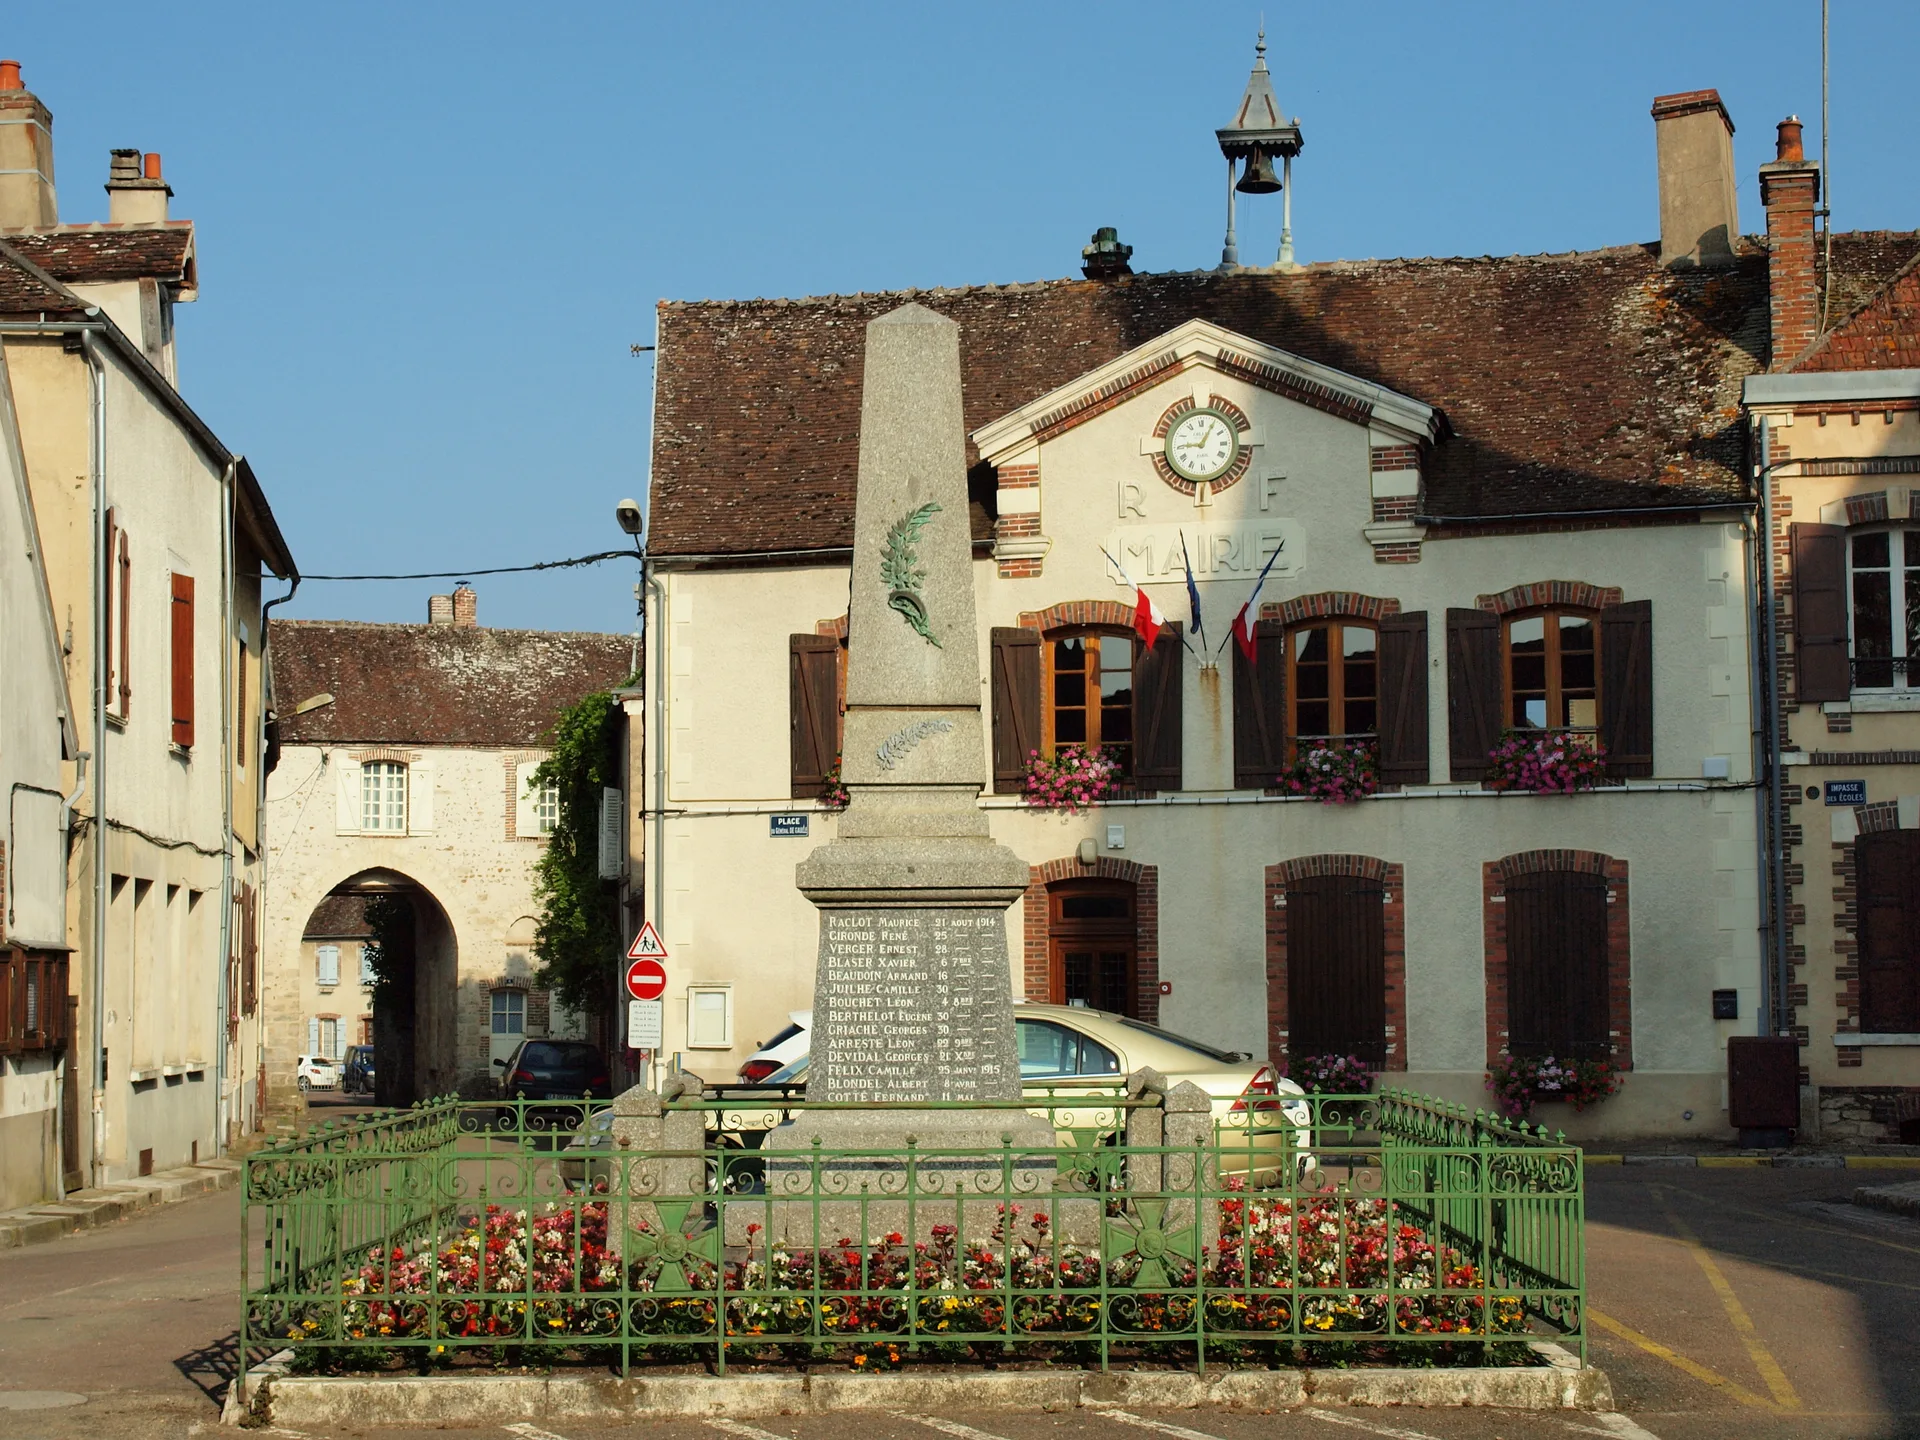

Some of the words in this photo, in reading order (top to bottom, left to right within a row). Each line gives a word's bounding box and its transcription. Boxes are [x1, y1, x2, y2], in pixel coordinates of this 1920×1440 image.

[1118, 479, 1147, 518] R
[1260, 471, 1286, 511] F
[1119, 529, 1289, 576] MAIRIE
[1839, 793, 1863, 801] ÉCOLES
[778, 817, 800, 825] PLACE
[829, 916, 873, 927] RACLOT
[879, 917, 920, 927] MAURICE
[935, 918, 946, 927] 21
[951, 919, 973, 927] AOUT
[977, 917, 996, 928] 1914
[935, 931, 948, 940] 25
[829, 943, 874, 954] VERGER
[880, 944, 918, 954] ERNEST
[935, 945, 948, 954] 28
[828, 956, 873, 968] BLASER
[878, 957, 917, 968] XAVIER
[941, 958, 948, 967] 6
[886, 972, 928, 981] ARMAND
[938, 971, 948, 980] 16
[876, 984, 921, 994] CAMILLE
[936, 984, 948, 994] 30
[829, 996, 881, 1008] BOUCHET
[941, 997, 948, 1006] 4
[829, 1010, 895, 1021] BERTHELOT
[937, 1012, 949, 1021] 30
[884, 1024, 927, 1035] GEORGES
[938, 1025, 949, 1034] 30
[828, 1038, 883, 1048] ARRESTE
[828, 1051, 881, 1062] DEVIDAL
[885, 1052, 928, 1062] GEORGES
[940, 1051, 949, 1061] 21
[868, 1065, 915, 1075] CAMILLE
[938, 1065, 950, 1074] 25
[981, 1065, 1000, 1074] 1915
[828, 1078, 882, 1089] BLONDEL
[887, 1079, 928, 1089] ALBERT
[944, 1079, 950, 1087] 8
[874, 1092, 924, 1102] FERNAND
